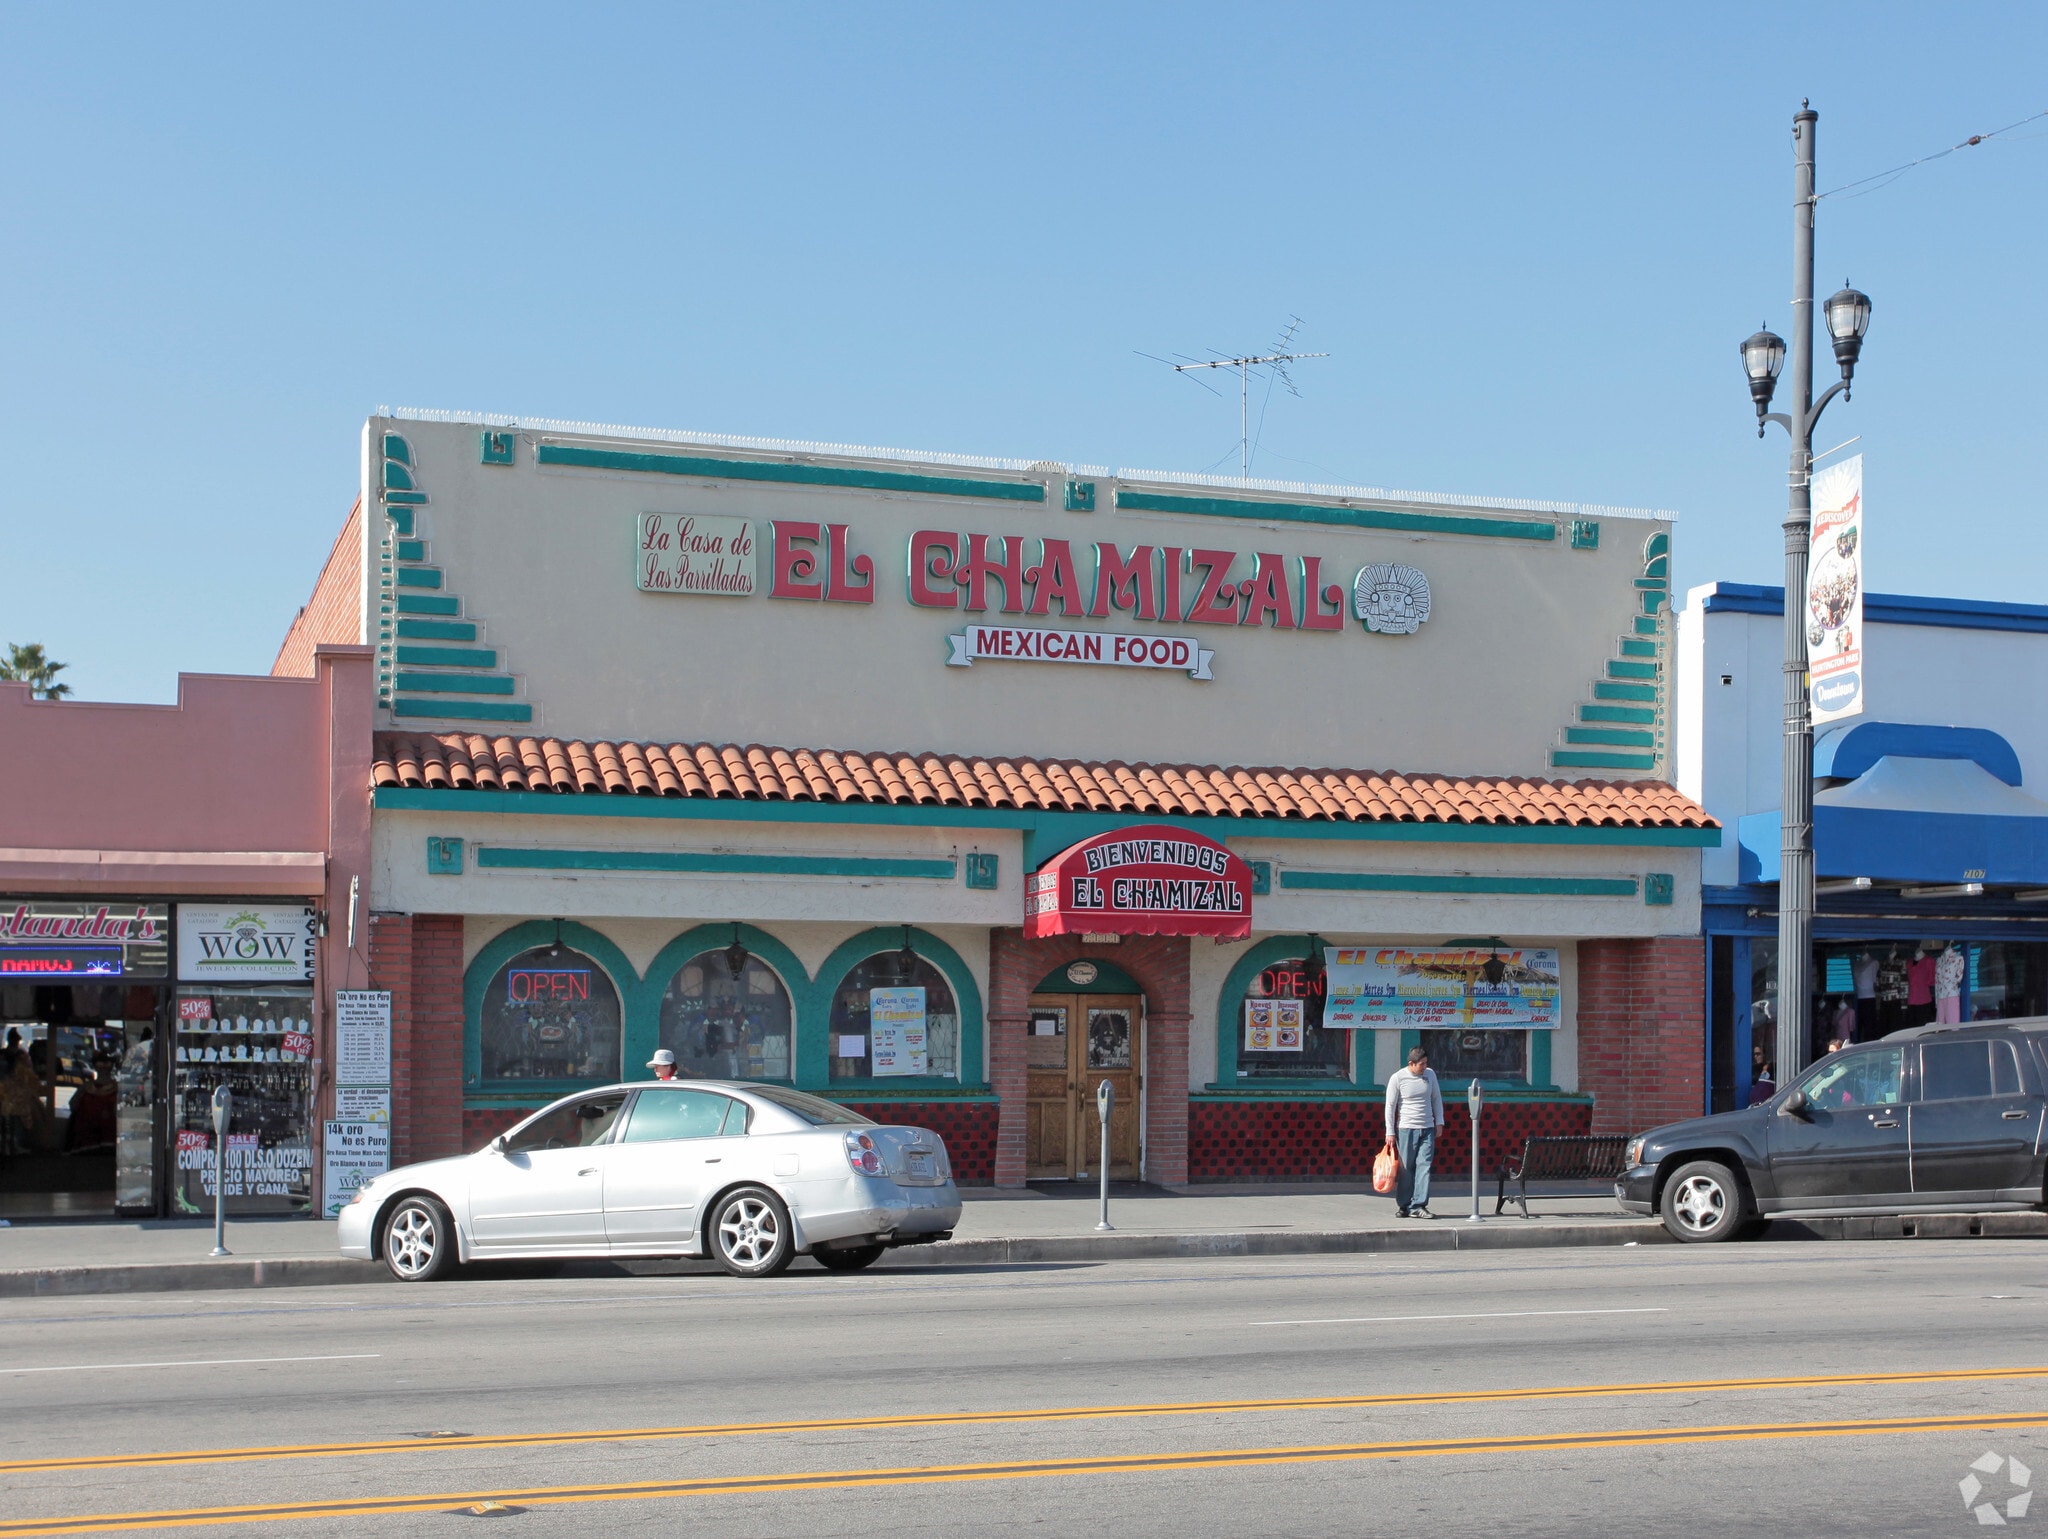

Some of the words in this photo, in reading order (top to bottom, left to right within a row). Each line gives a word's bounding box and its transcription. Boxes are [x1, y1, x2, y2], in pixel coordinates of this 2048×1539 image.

[642, 515, 670, 550] La
[677, 517, 723, 554] Casa
[731, 523, 752, 556] de
[643, 553, 671, 588] Las
[674, 554, 753, 593] Parrilladas
[768, 520, 875, 604] EL
[907, 530, 1345, 630] CHAMIZAL
[976, 629, 1101, 660] MEXICAN
[1113, 636, 1190, 666] FOOD
[1083, 838, 1230, 876] BIENVENIDOS
[1965, 869, 1985, 878] 7107
[1072, 877, 1104, 908] EL
[1113, 878, 1243, 912] CHAMIZAL
[198, 936, 296, 958] WOW
[1336, 950, 1366, 965] El
[1526, 958, 1557, 970] Corona
[511, 972, 588, 1001] OPEN
[1259, 970, 1327, 997] OPEN
[1364, 983, 1385, 996] Martes
[181, 1001, 210, 1015] 50%
[284, 1034, 313, 1050] 50%
[328, 1124, 343, 1134] 14k
[347, 1125, 363, 1134] oro
[178, 1133, 208, 1146] 50%
[228, 1135, 257, 1144] SALE
[342, 1136, 352, 1145] No
[355, 1136, 365, 1145] es
[368, 1136, 387, 1145] Puro
[225, 1149, 242, 1168] 100
[201, 1169, 242, 1183] PRCIO
[245, 1169, 299, 1182] MAYOREO
[246, 1184, 254, 1195] Y
[256, 1183, 289, 1194] GANA
